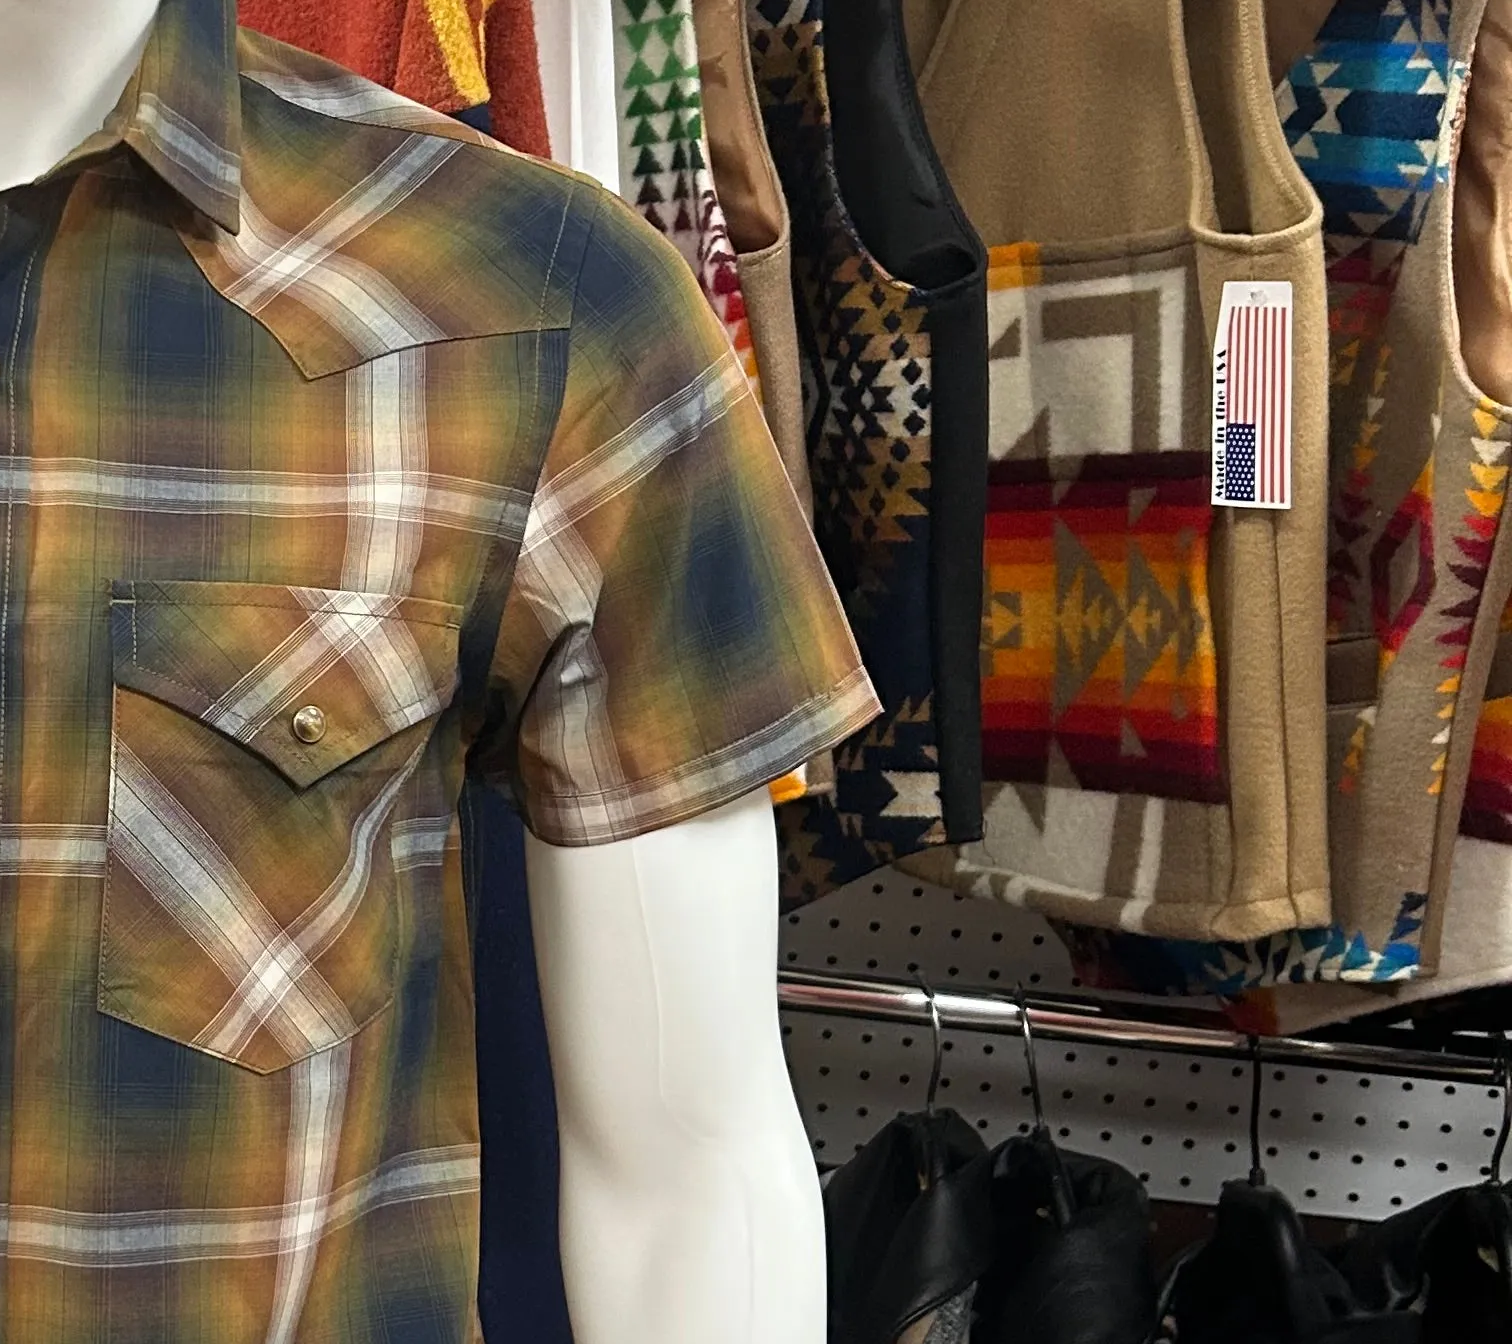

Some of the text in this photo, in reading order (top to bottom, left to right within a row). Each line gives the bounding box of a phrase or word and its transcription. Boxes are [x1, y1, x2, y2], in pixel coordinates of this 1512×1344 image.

[1215, 349, 1227, 384] USA
[1215, 390, 1226, 420] the
[1215, 450, 1226, 500] Made
